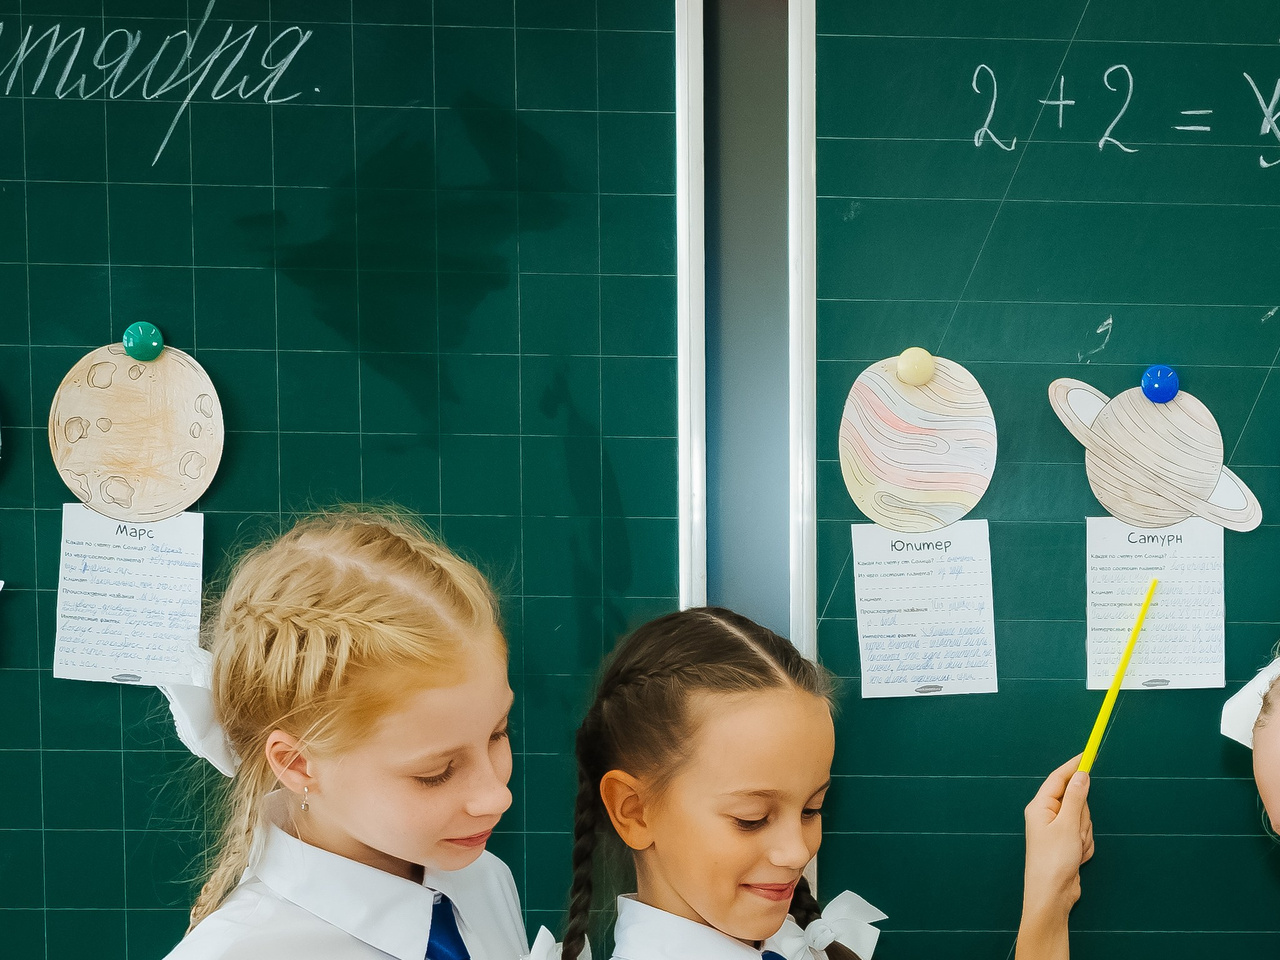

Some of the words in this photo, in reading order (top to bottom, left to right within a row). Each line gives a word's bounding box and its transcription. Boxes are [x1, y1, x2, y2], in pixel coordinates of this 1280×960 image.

[0, 0, 322, 167] тября.
[971, 63, 1017, 151] 2
[1038, 75, 1076, 129] +
[1098, 63, 1140, 152] 2
[1170, 108, 1214, 132] =
[115, 523, 155, 541] Марс
[1127, 531, 1184, 547] Сатурн
[890, 539, 952, 553] Юпитер
